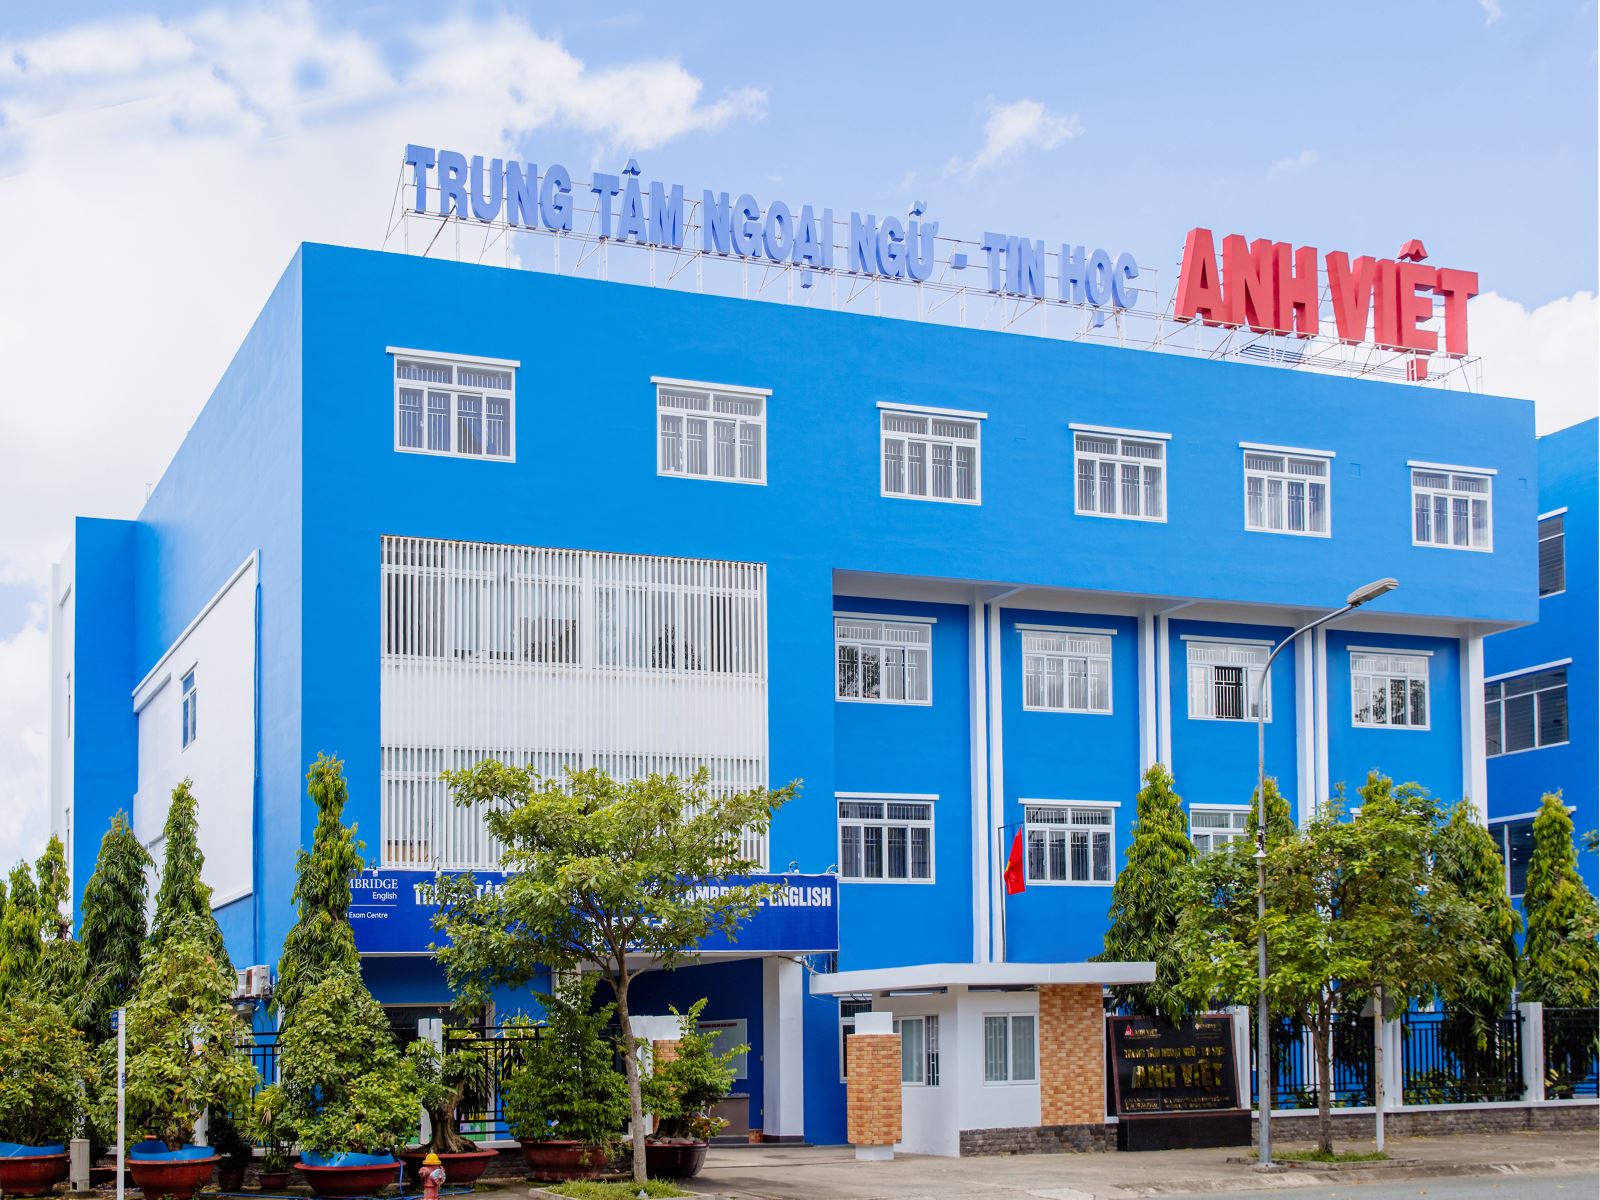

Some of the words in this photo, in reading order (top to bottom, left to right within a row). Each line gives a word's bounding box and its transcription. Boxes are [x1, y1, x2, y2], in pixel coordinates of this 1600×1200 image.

[405, 143, 574, 232] TRUNG
[591, 158, 684, 250] TÂM
[703, 189, 833, 289] NGOẠI
[848, 200, 940, 282] NGỮ
[951, 253, 968, 270] -
[980, 231, 1046, 300] TIN
[1058, 243, 1139, 328] HỌC
[1173, 227, 1319, 339] ANH
[1325, 239, 1479, 381] VIỆT
[372, 891, 398, 902] English
[769, 886, 832, 907] ENGLISH
[348, 911, 366, 919] Exam
[366, 911, 389, 919] Centre
[1131, 1064, 1176, 1089] ANH
